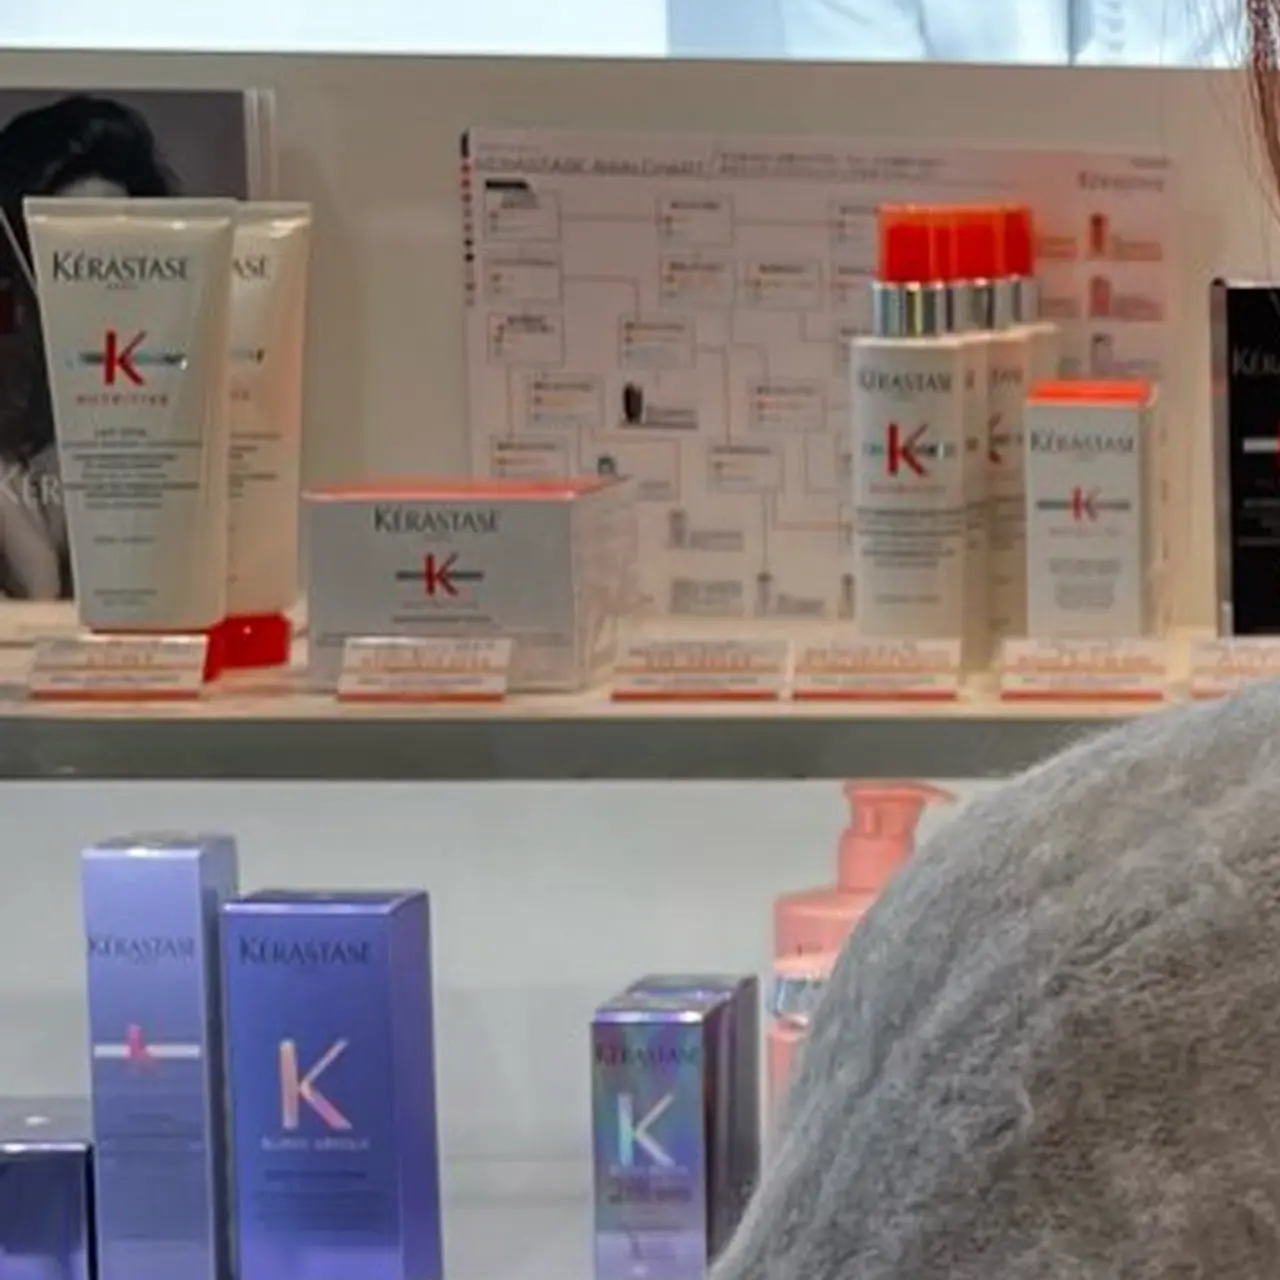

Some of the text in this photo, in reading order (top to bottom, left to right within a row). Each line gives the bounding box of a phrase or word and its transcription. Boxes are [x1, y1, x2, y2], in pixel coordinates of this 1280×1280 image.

[52, 250, 189, 283] KÉRASTASE
[103, 330, 147, 386] K
[886, 422, 930, 477] K
[424, 552, 460, 597] K
[279, 1039, 353, 1131] K
[617, 1093, 676, 1168] K
